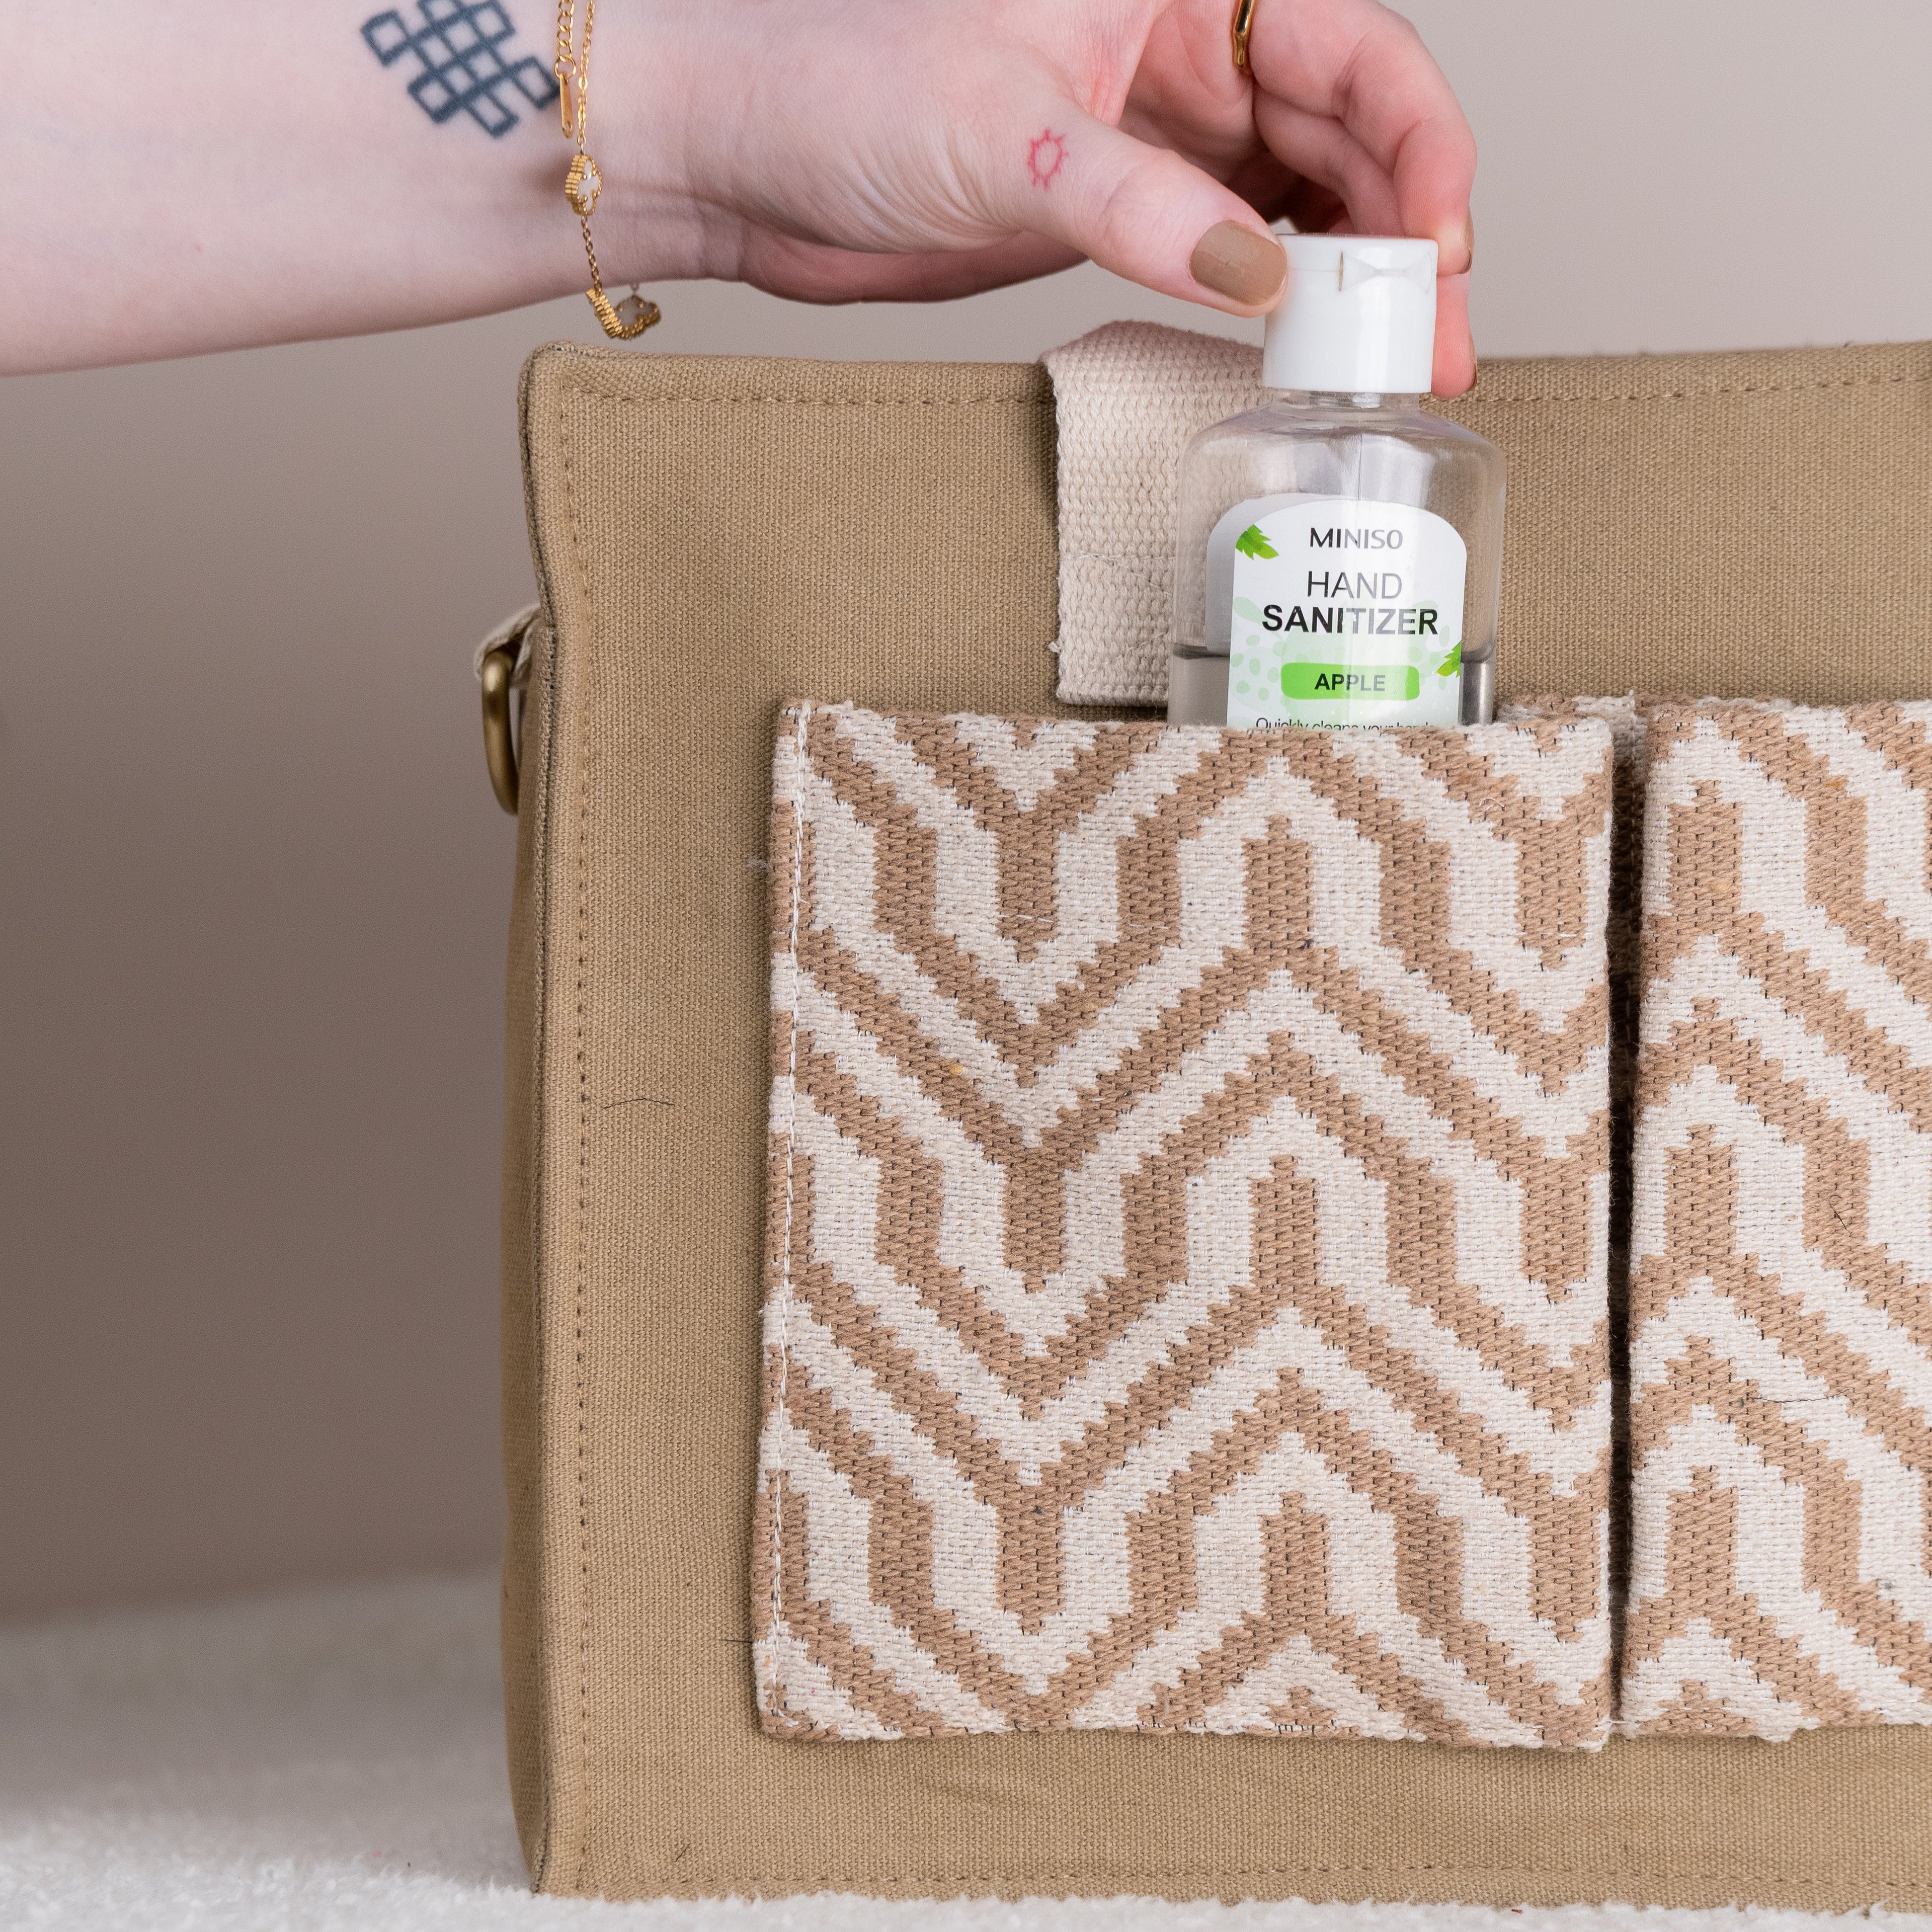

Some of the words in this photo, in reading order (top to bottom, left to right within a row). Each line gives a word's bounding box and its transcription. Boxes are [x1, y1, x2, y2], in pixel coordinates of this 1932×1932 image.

[1310, 528, 1403, 549] MINISO
[1308, 572, 1402, 599] HAND
[1262, 605, 1438, 634] SANITIZER
[1315, 674, 1386, 691] APPLE
[1256, 717, 1308, 729] Quickl
